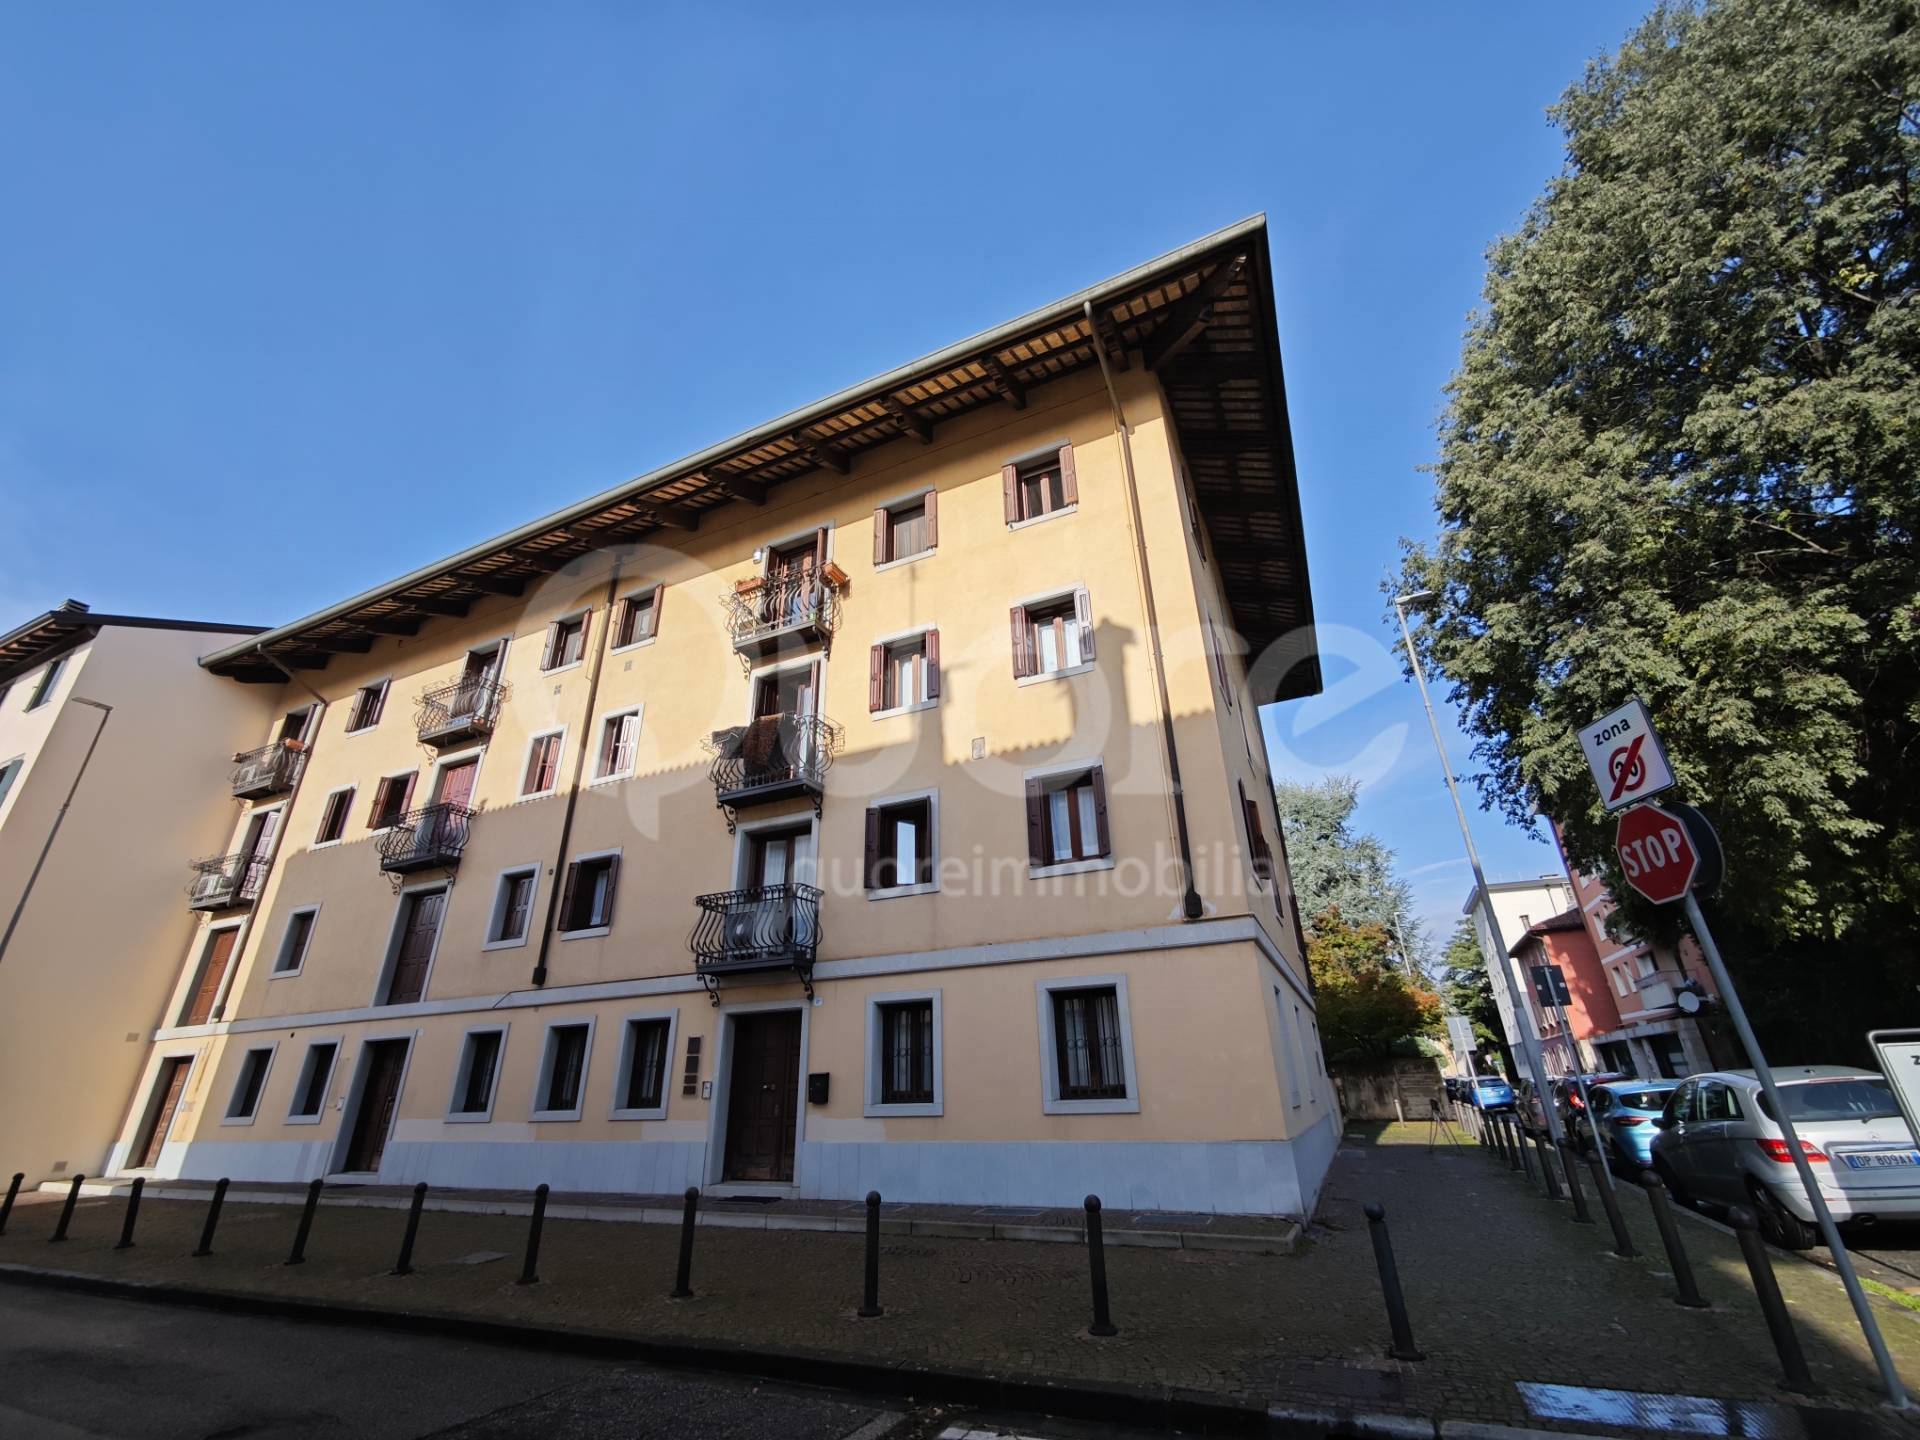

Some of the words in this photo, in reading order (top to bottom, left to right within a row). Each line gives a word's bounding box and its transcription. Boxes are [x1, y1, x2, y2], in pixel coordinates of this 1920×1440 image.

[1593, 719, 1631, 746] zona
[1621, 828, 1681, 877] STOP
[1856, 1156, 1871, 1167] DP
